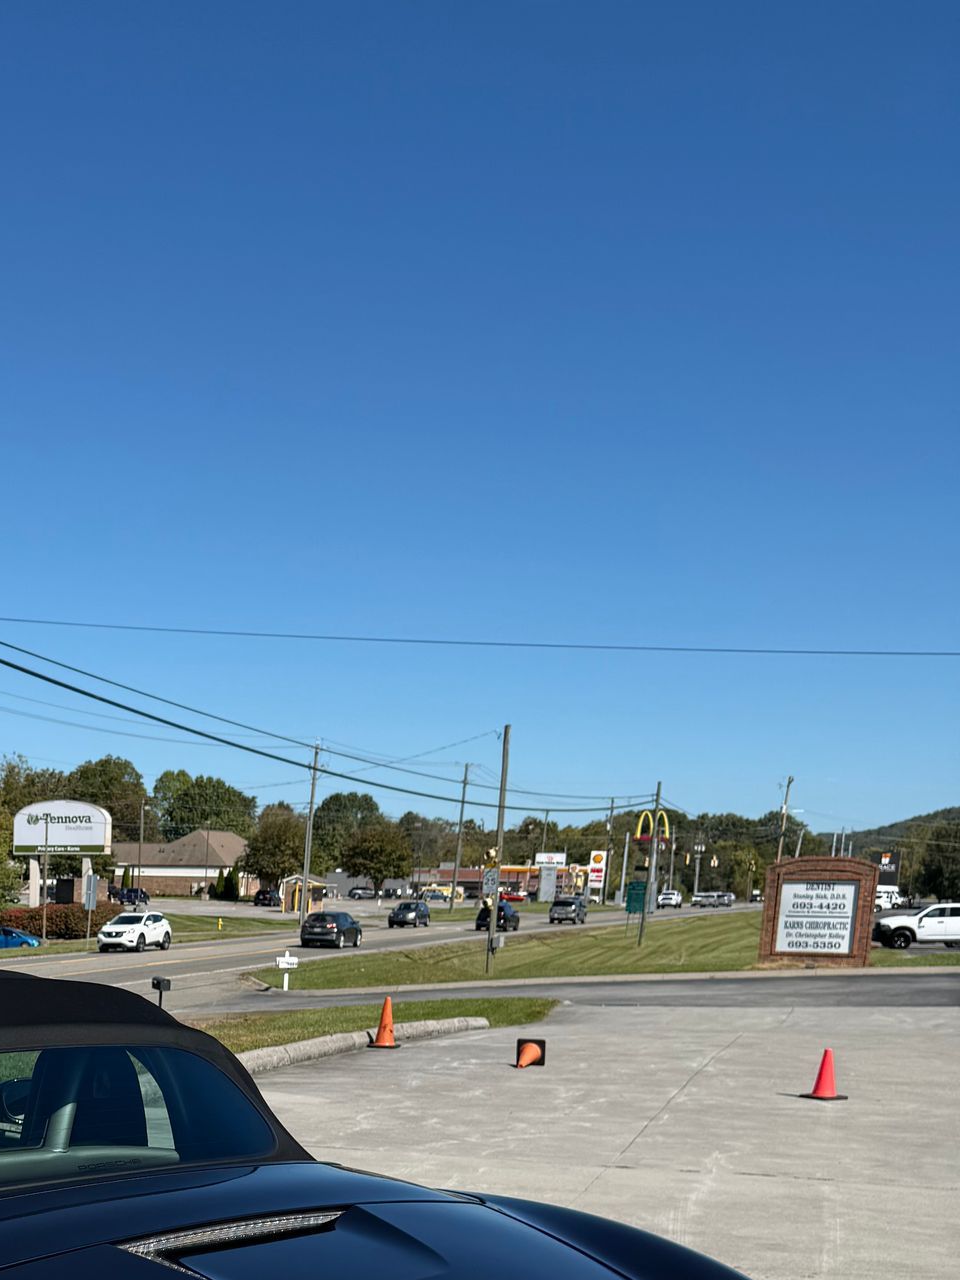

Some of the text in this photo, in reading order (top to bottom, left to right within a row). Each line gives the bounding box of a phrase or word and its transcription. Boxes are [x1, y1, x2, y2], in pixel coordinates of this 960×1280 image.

[42, 812, 92, 824] Tennova
[805, 882, 836, 891] DENTIST
[792, 901, 846, 910] 693-4420
[783, 920, 849, 931] KARNS CHIROPRACTIC
[787, 940, 841, 950] 693-5350
